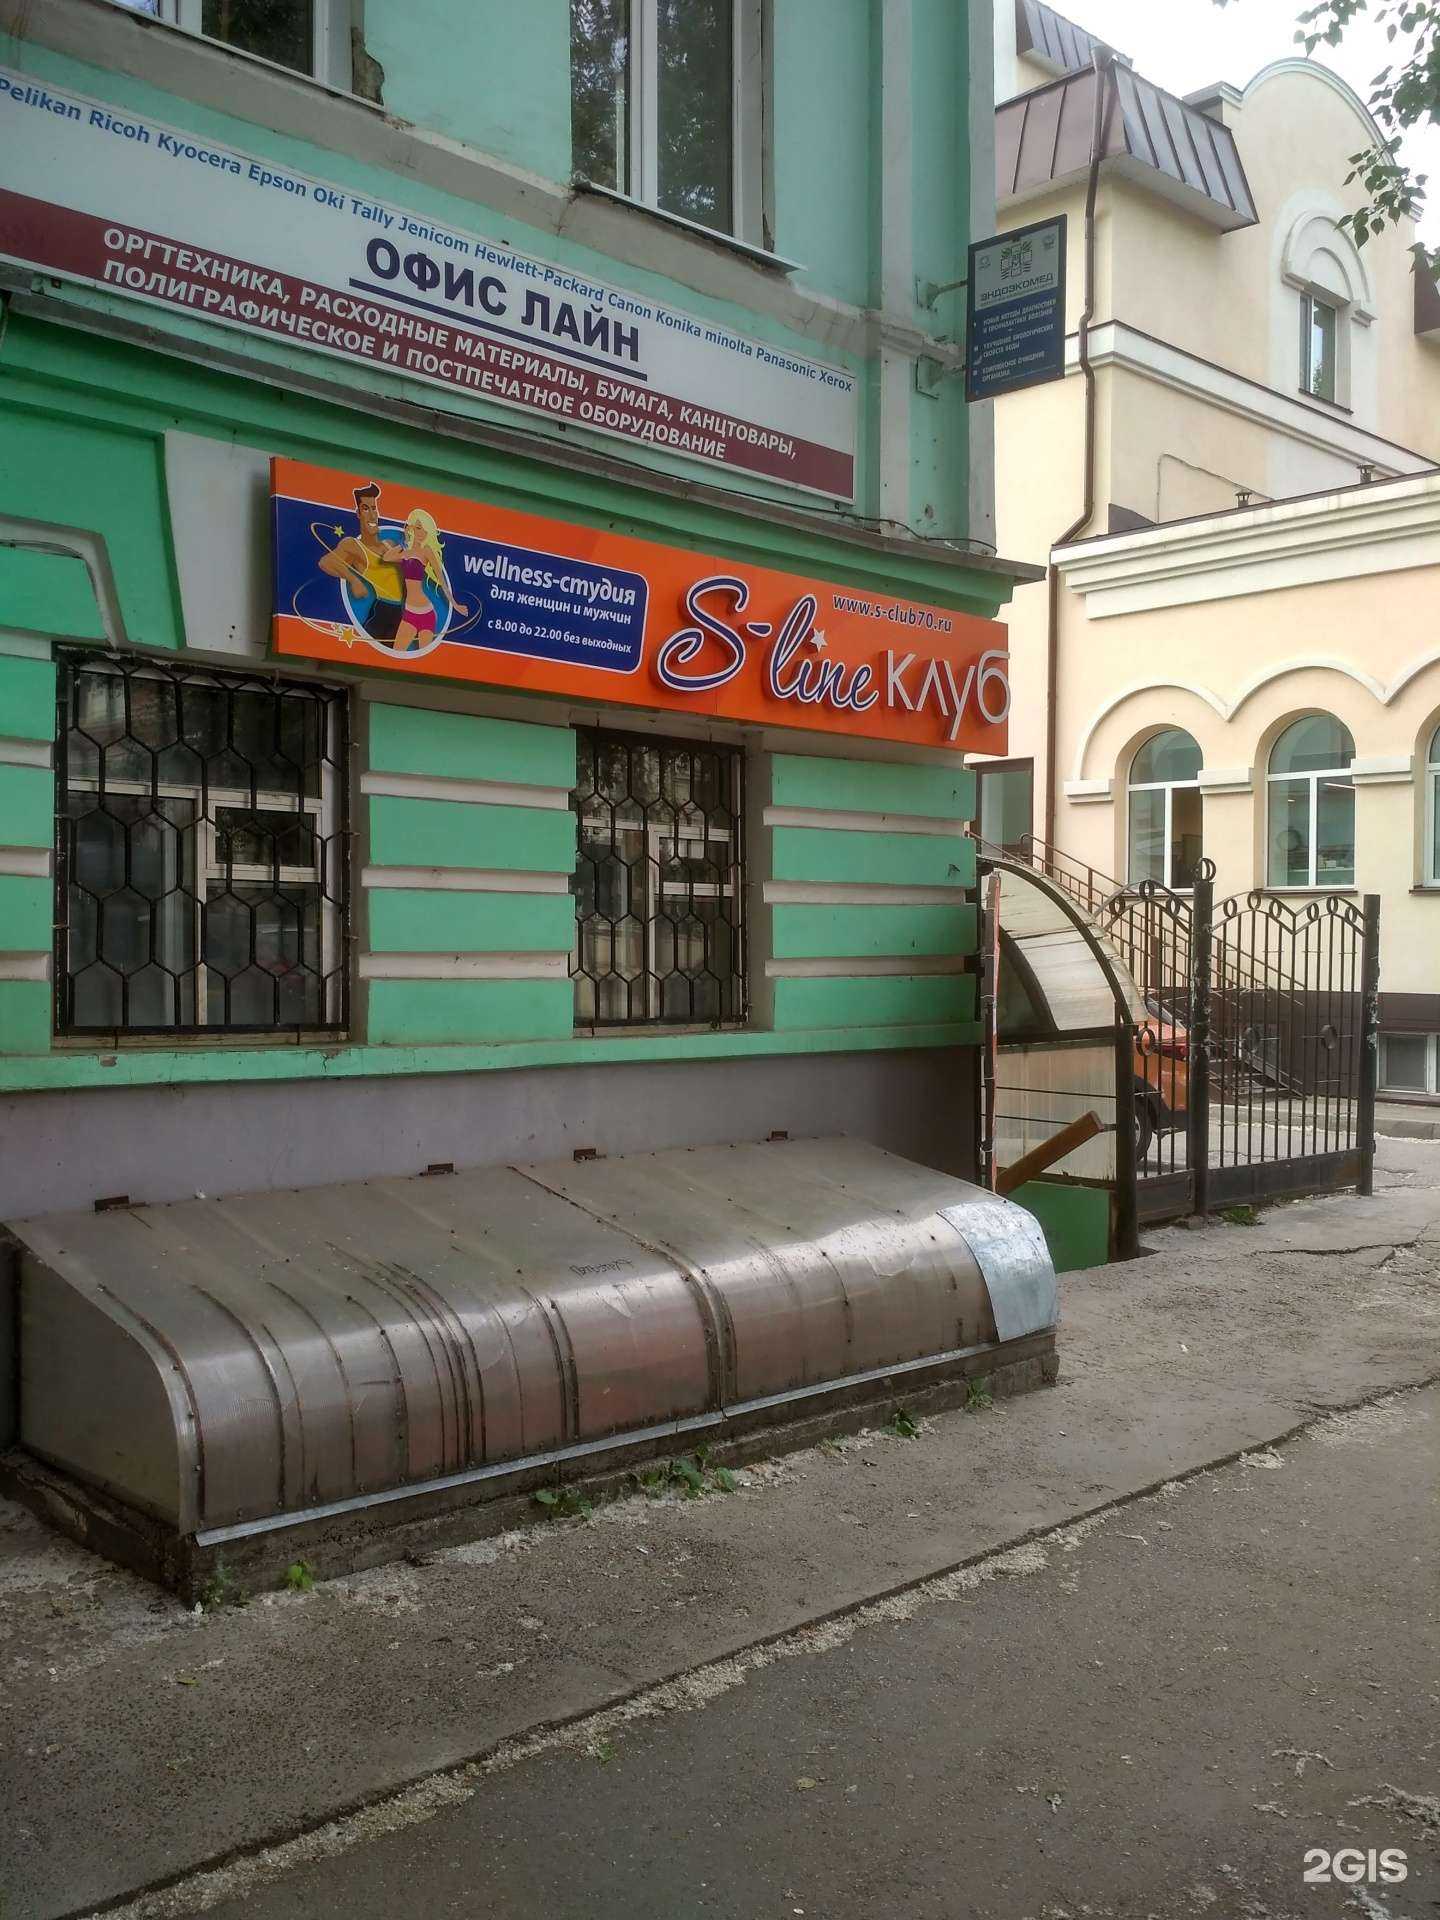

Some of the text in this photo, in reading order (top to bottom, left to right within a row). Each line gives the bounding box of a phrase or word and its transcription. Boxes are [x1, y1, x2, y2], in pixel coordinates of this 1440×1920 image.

[89, 110, 150, 144] Ricoh
[158, 133, 241, 176] Kyocera
[248, 164, 307, 197] Epson
[313, 187, 345, 211] Oki
[351, 199, 394, 230] Tally
[399, 216, 469, 254] Jenicom
[474, 244, 605, 303] Hewlett-Packard
[608, 292, 652, 320] Canon
[656, 309, 702, 338] Konika
[704, 328, 752, 356] minolta
[756, 347, 817, 380] Panasonic
[819, 369, 853, 393] Xerox
[366, 237, 640, 363] ОФИС ЛАЙН
[102, 227, 798, 460] ОРГТЕХНИКА, РАСХОДНЫЕ МАТЕРИАЛЫ, БУМАГА, КАНЦТОВАРЫ,
[102, 258, 727, 460] ПОЛИГРАФИЧЕСКОЕ И ПОСТПЕЧАТНОЕ ОБОРУДОВАНИЕ
[463, 554, 637, 606] wellness-студия
[487, 618, 632, 654] с 8.00 до 22.00 без выходных
[489, 583, 632, 625] для женщин и мужчин
[656, 574, 880, 712] S-line
[832, 593, 953, 634] www.s-club70.ru
